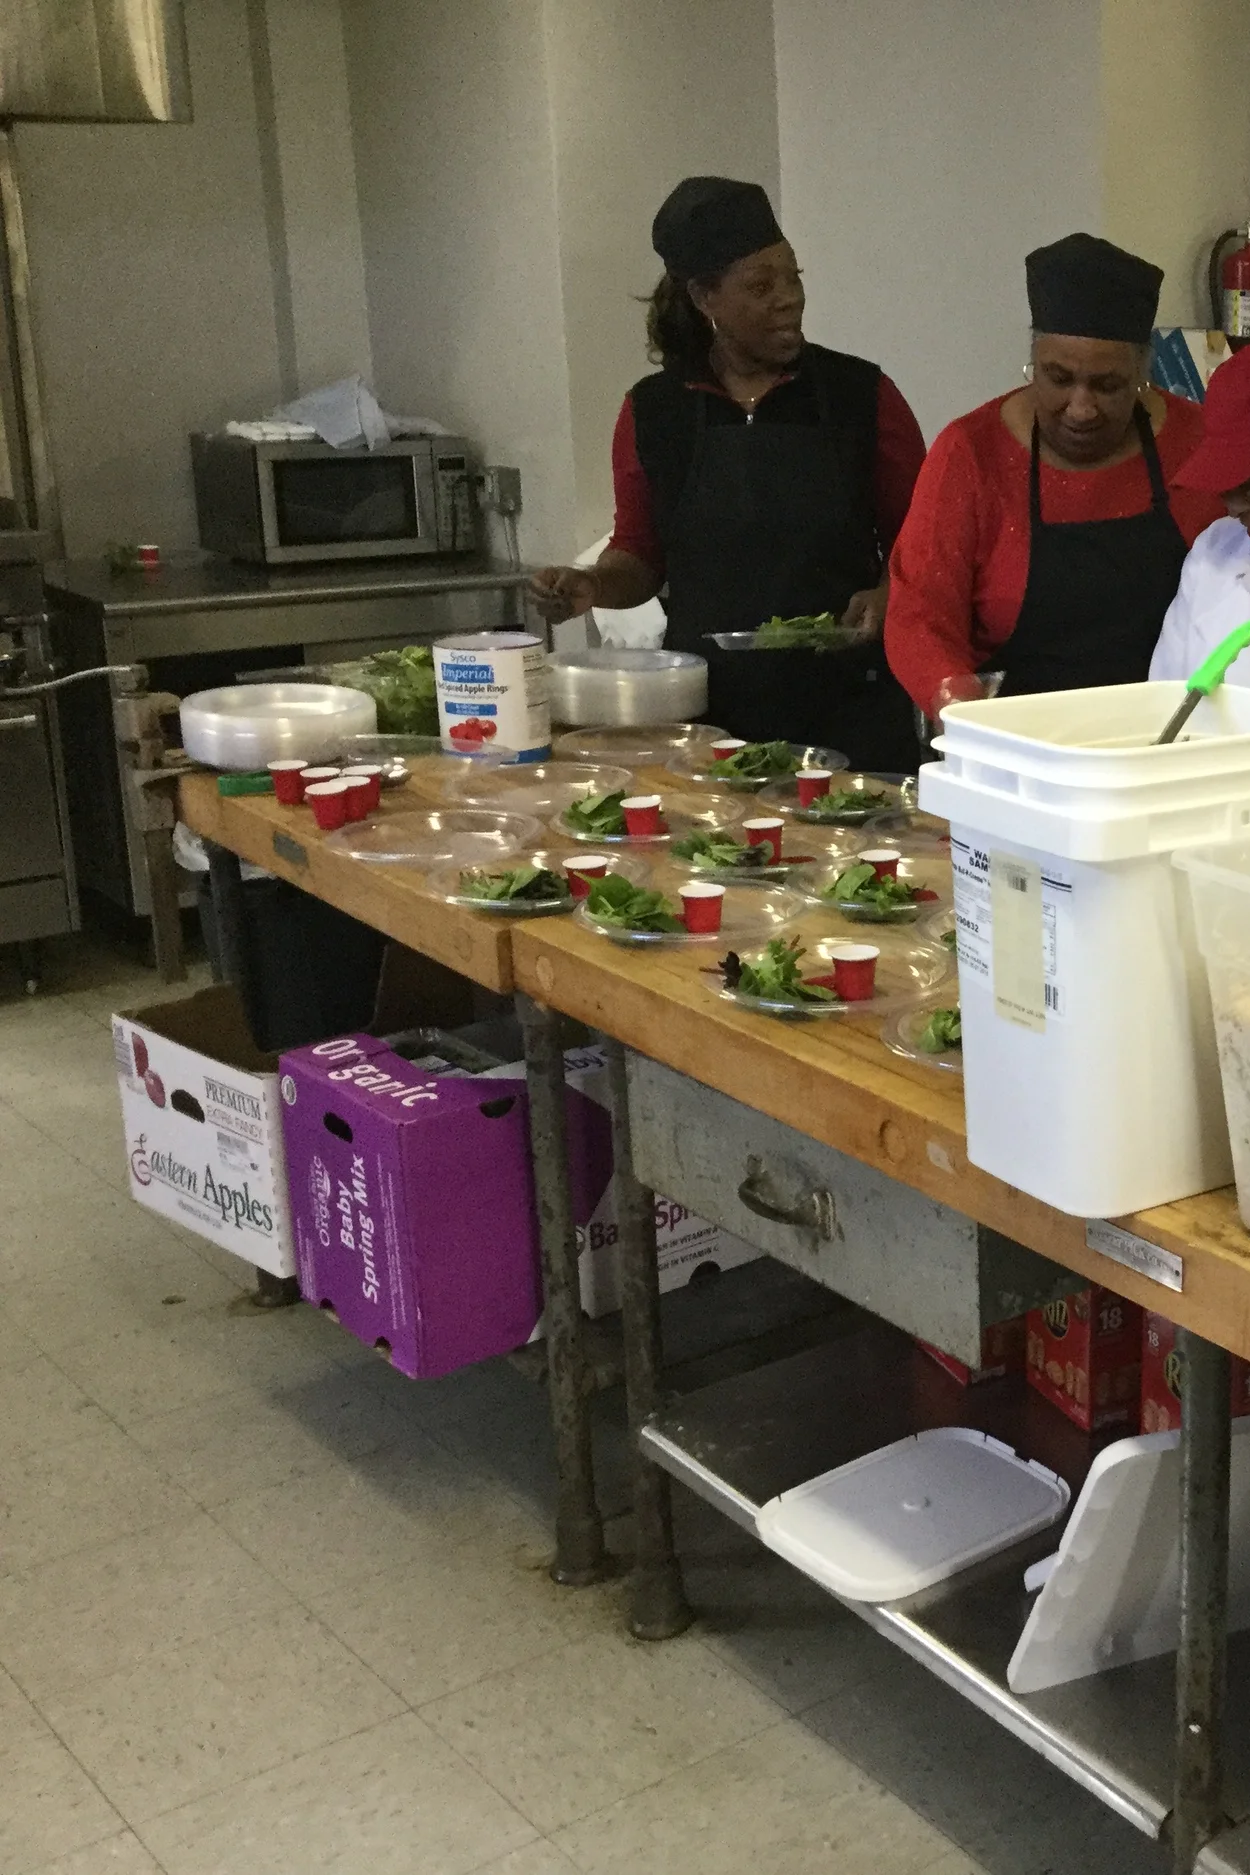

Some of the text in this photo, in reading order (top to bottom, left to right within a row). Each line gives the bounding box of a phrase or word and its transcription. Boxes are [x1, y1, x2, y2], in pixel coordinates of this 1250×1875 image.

[450, 652, 477, 663] Sysco
[442, 664, 494, 681] Imperial
[464, 684, 485, 694] Apple
[486, 685, 509, 694] Rings
[969, 856, 990, 872] SAM
[974, 849, 990, 863] WA
[312, 1039, 438, 1107] Organic
[205, 1080, 262, 1121] PREMIUM
[206, 1105, 263, 1140] EXTRA FANCY
[131, 1133, 199, 1194] Eastern
[203, 1163, 273, 1231] Apples
[336, 1179, 355, 1251] Baby
[350, 1153, 380, 1304] Spring Mix
[680, 1227, 712, 1244] VITAMIN
[680, 1246, 712, 1263] VITAMIN
[1100, 1306, 1122, 1331] 18
[1147, 1329, 1160, 1347] 18
